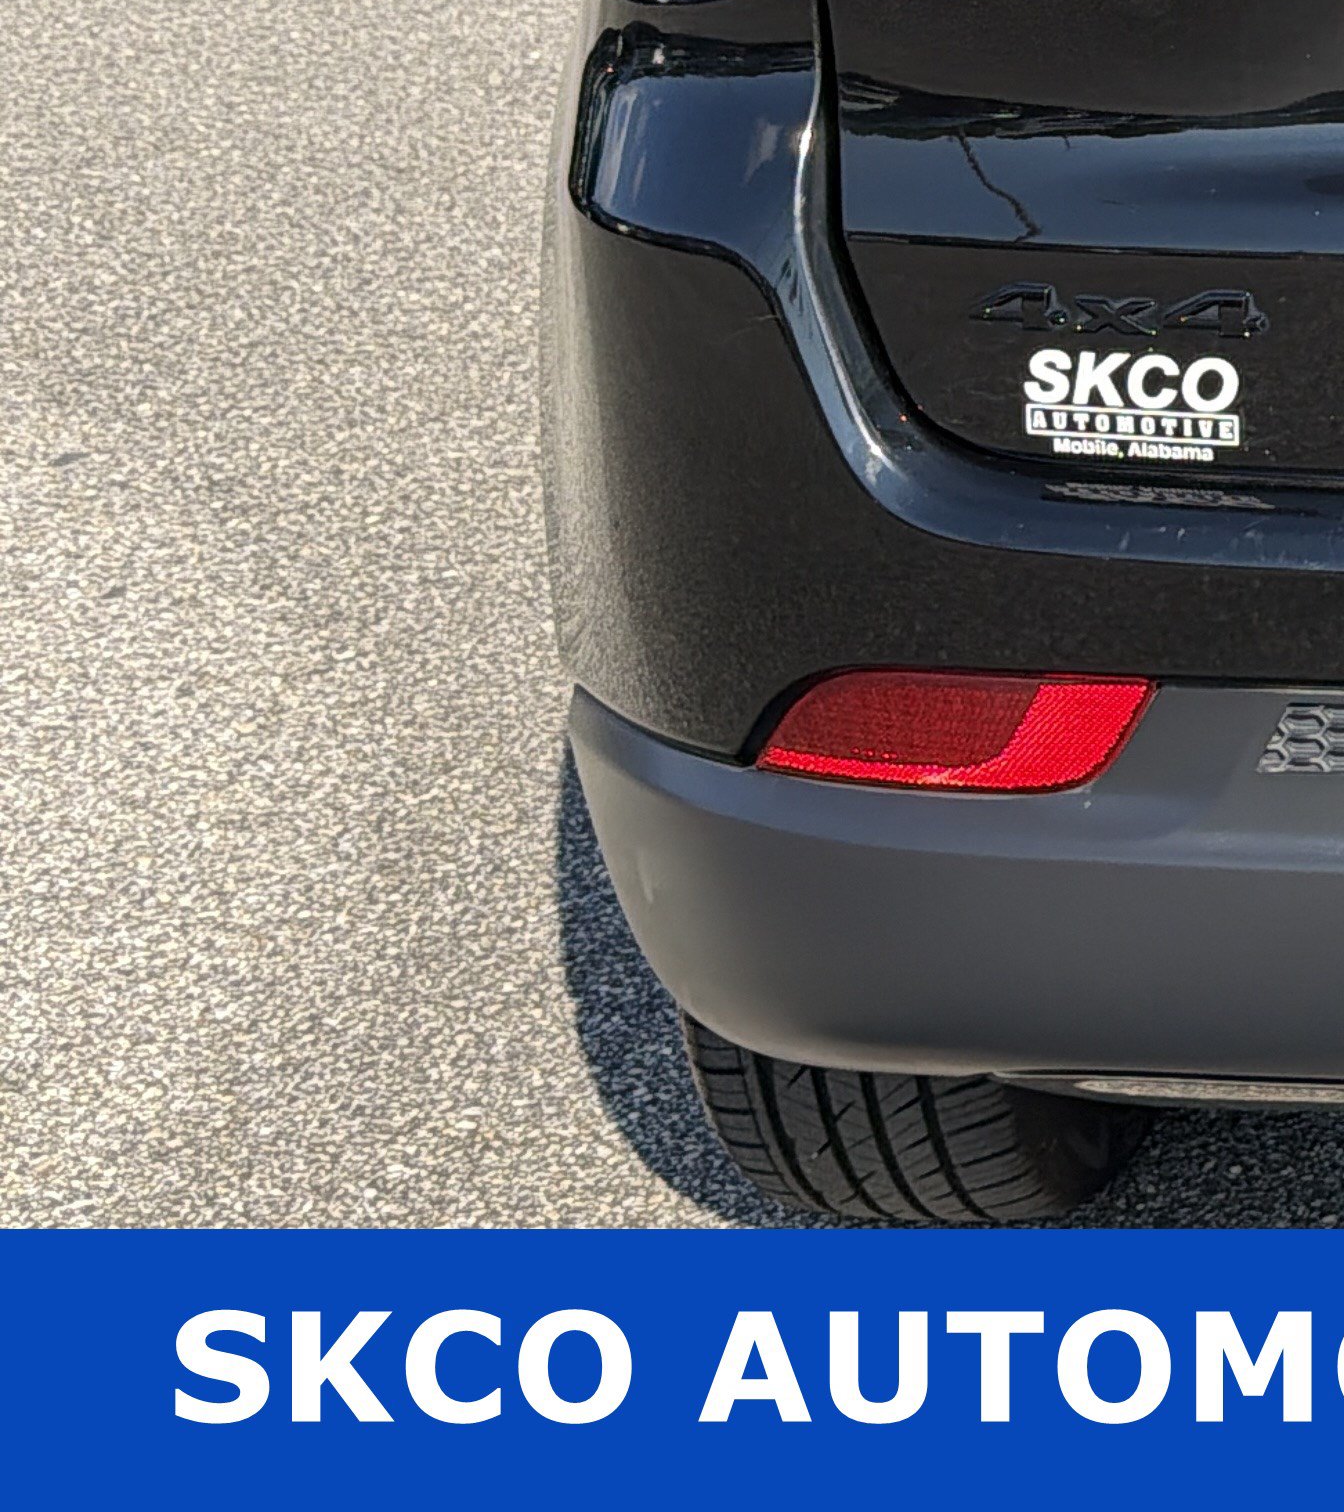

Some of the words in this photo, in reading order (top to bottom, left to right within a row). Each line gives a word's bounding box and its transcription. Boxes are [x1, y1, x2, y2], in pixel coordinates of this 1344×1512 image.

[969, 282, 1270, 337] 4x4
[1024, 349, 1239, 412] SKCO
[1031, 410, 1234, 440] AUTOMOTIVE
[1053, 437, 1124, 458] Mobile,
[1127, 443, 1214, 462] Alabama
